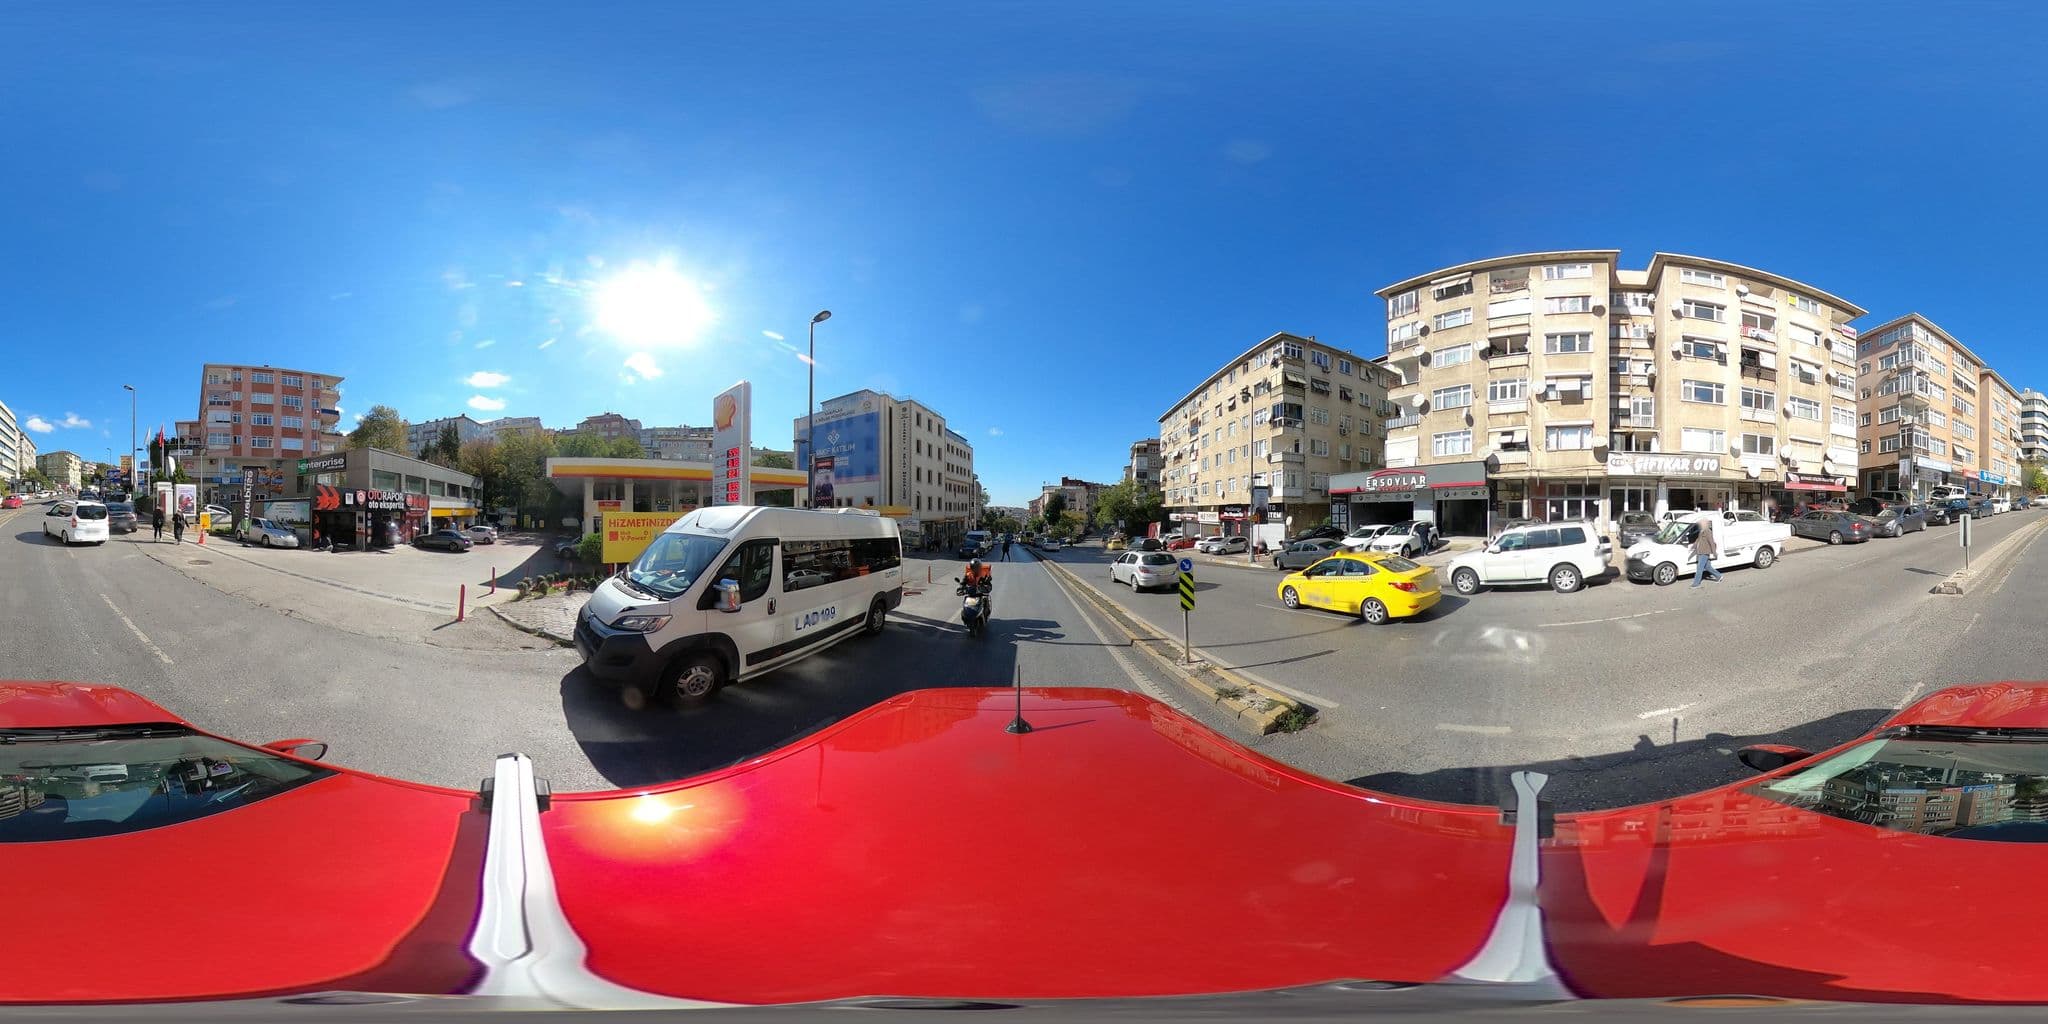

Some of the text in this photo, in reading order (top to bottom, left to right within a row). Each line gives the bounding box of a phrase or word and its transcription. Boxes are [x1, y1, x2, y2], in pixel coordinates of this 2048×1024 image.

[1693, 458, 1718, 471] OTO
[1366, 475, 1426, 488] ERSOYLAR
[368, 501, 378, 509] oto
